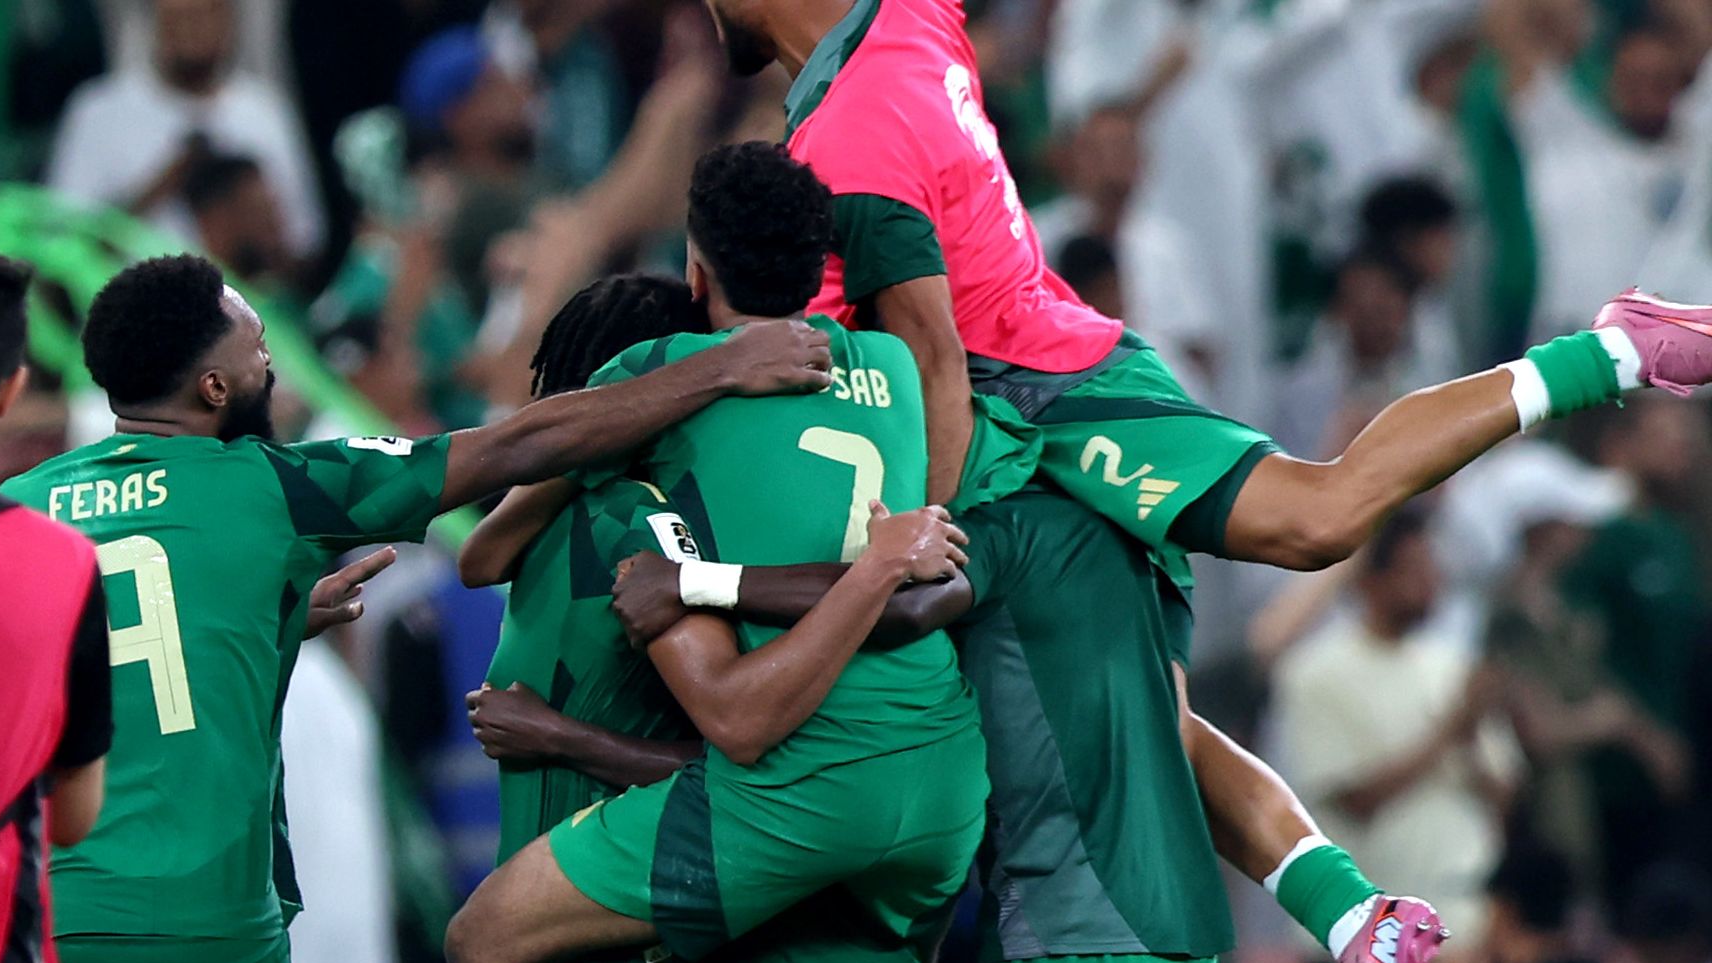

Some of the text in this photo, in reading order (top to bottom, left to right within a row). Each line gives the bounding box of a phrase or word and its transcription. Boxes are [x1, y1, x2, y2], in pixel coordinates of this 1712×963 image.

[819, 366, 892, 408] SAB
[1079, 434, 1155, 488] 2
[48, 469, 168, 521] FERAS
[797, 426, 885, 563] 7
